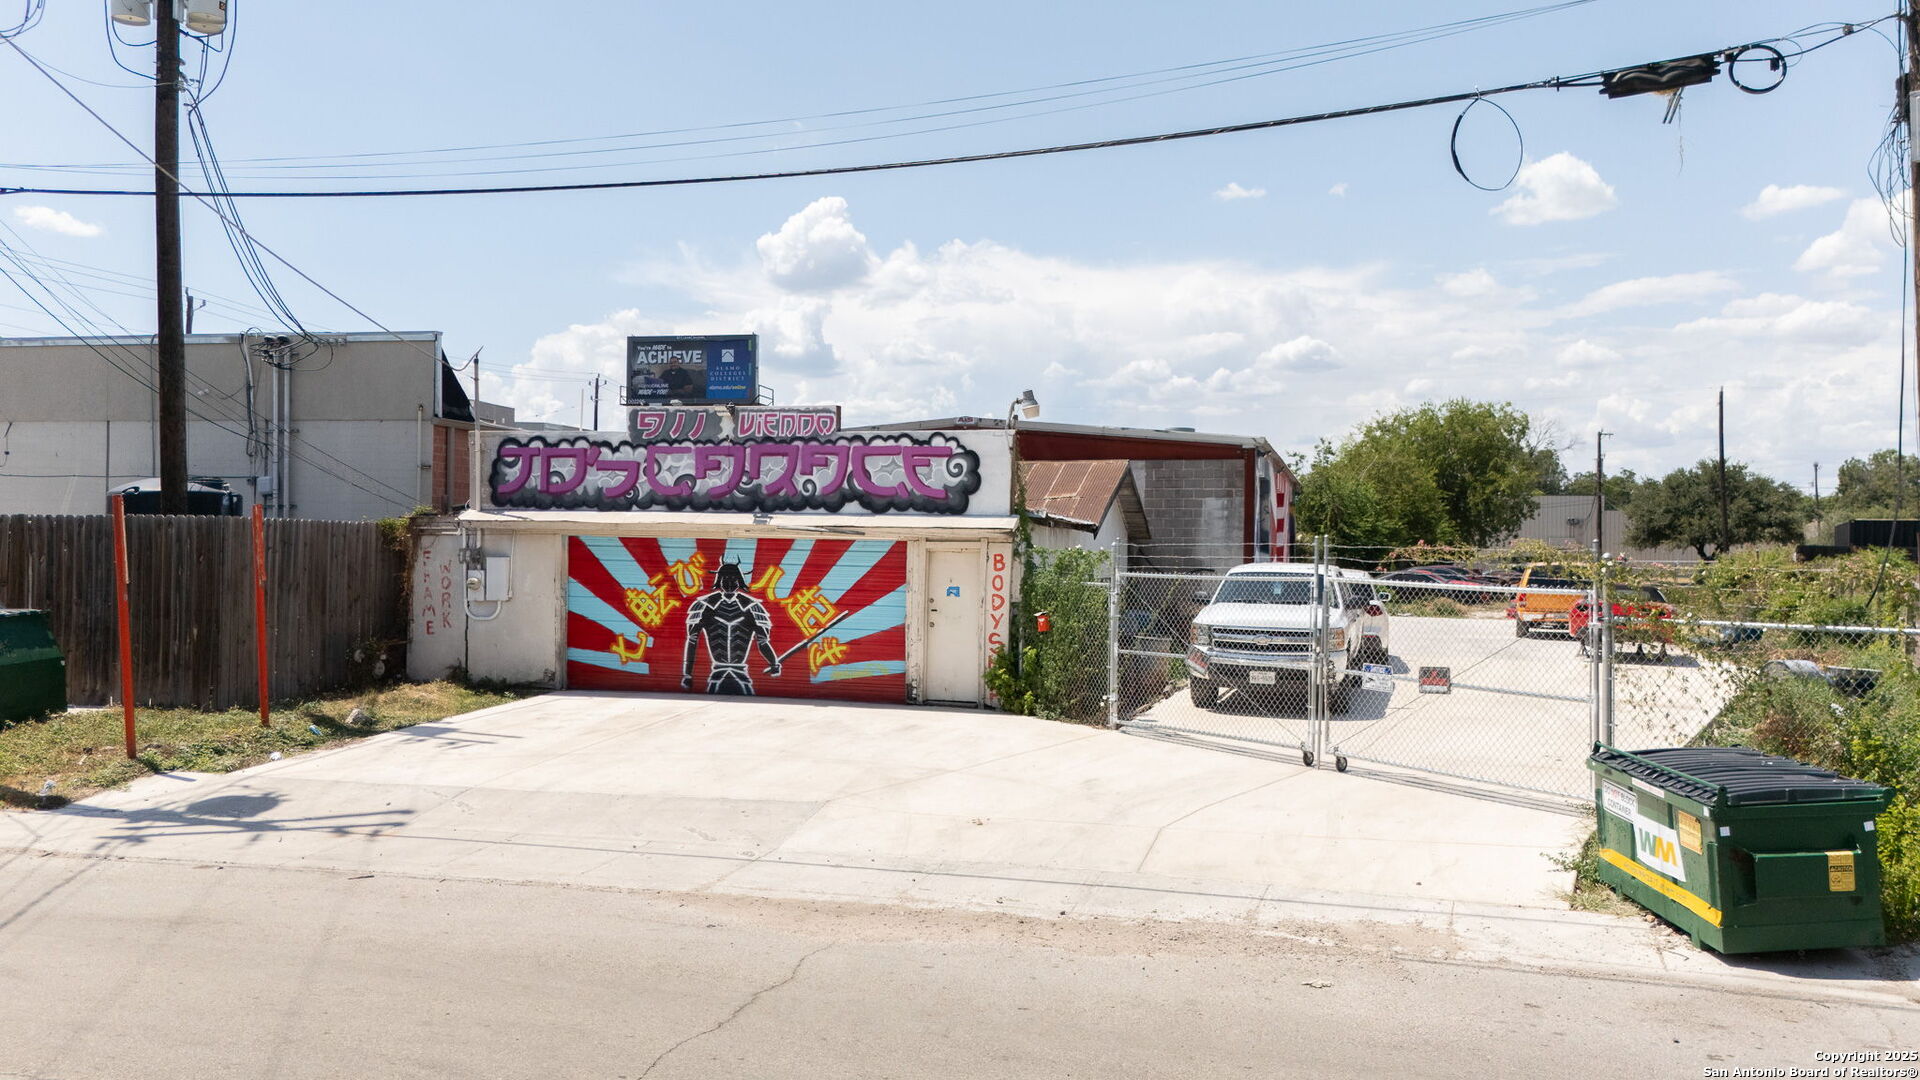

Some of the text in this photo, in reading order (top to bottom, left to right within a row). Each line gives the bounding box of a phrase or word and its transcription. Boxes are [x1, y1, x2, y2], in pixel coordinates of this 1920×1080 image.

[637, 350, 702, 364] ACHIEVE
[637, 411, 706, 440] 911
[647, 444, 952, 498] GARAGE
[1639, 827, 1679, 867] WM
